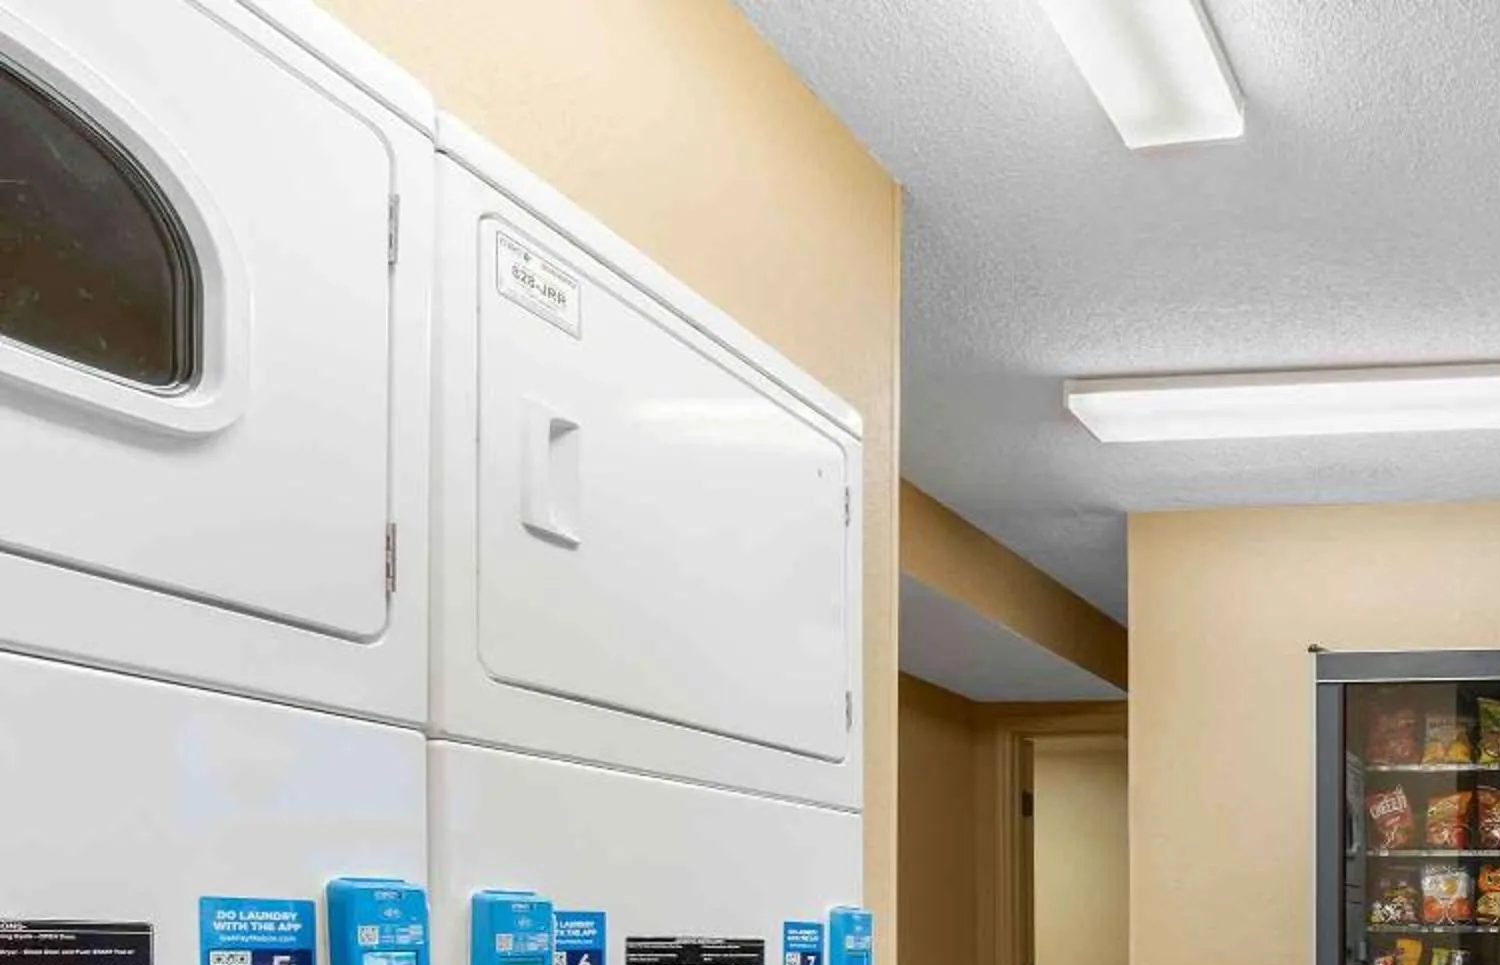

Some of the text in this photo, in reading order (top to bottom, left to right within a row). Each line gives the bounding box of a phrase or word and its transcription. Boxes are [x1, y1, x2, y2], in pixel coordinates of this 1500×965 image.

[216, 909, 298, 921] DO LAUNDRY
[213, 921, 303, 932] WITH THE APP
